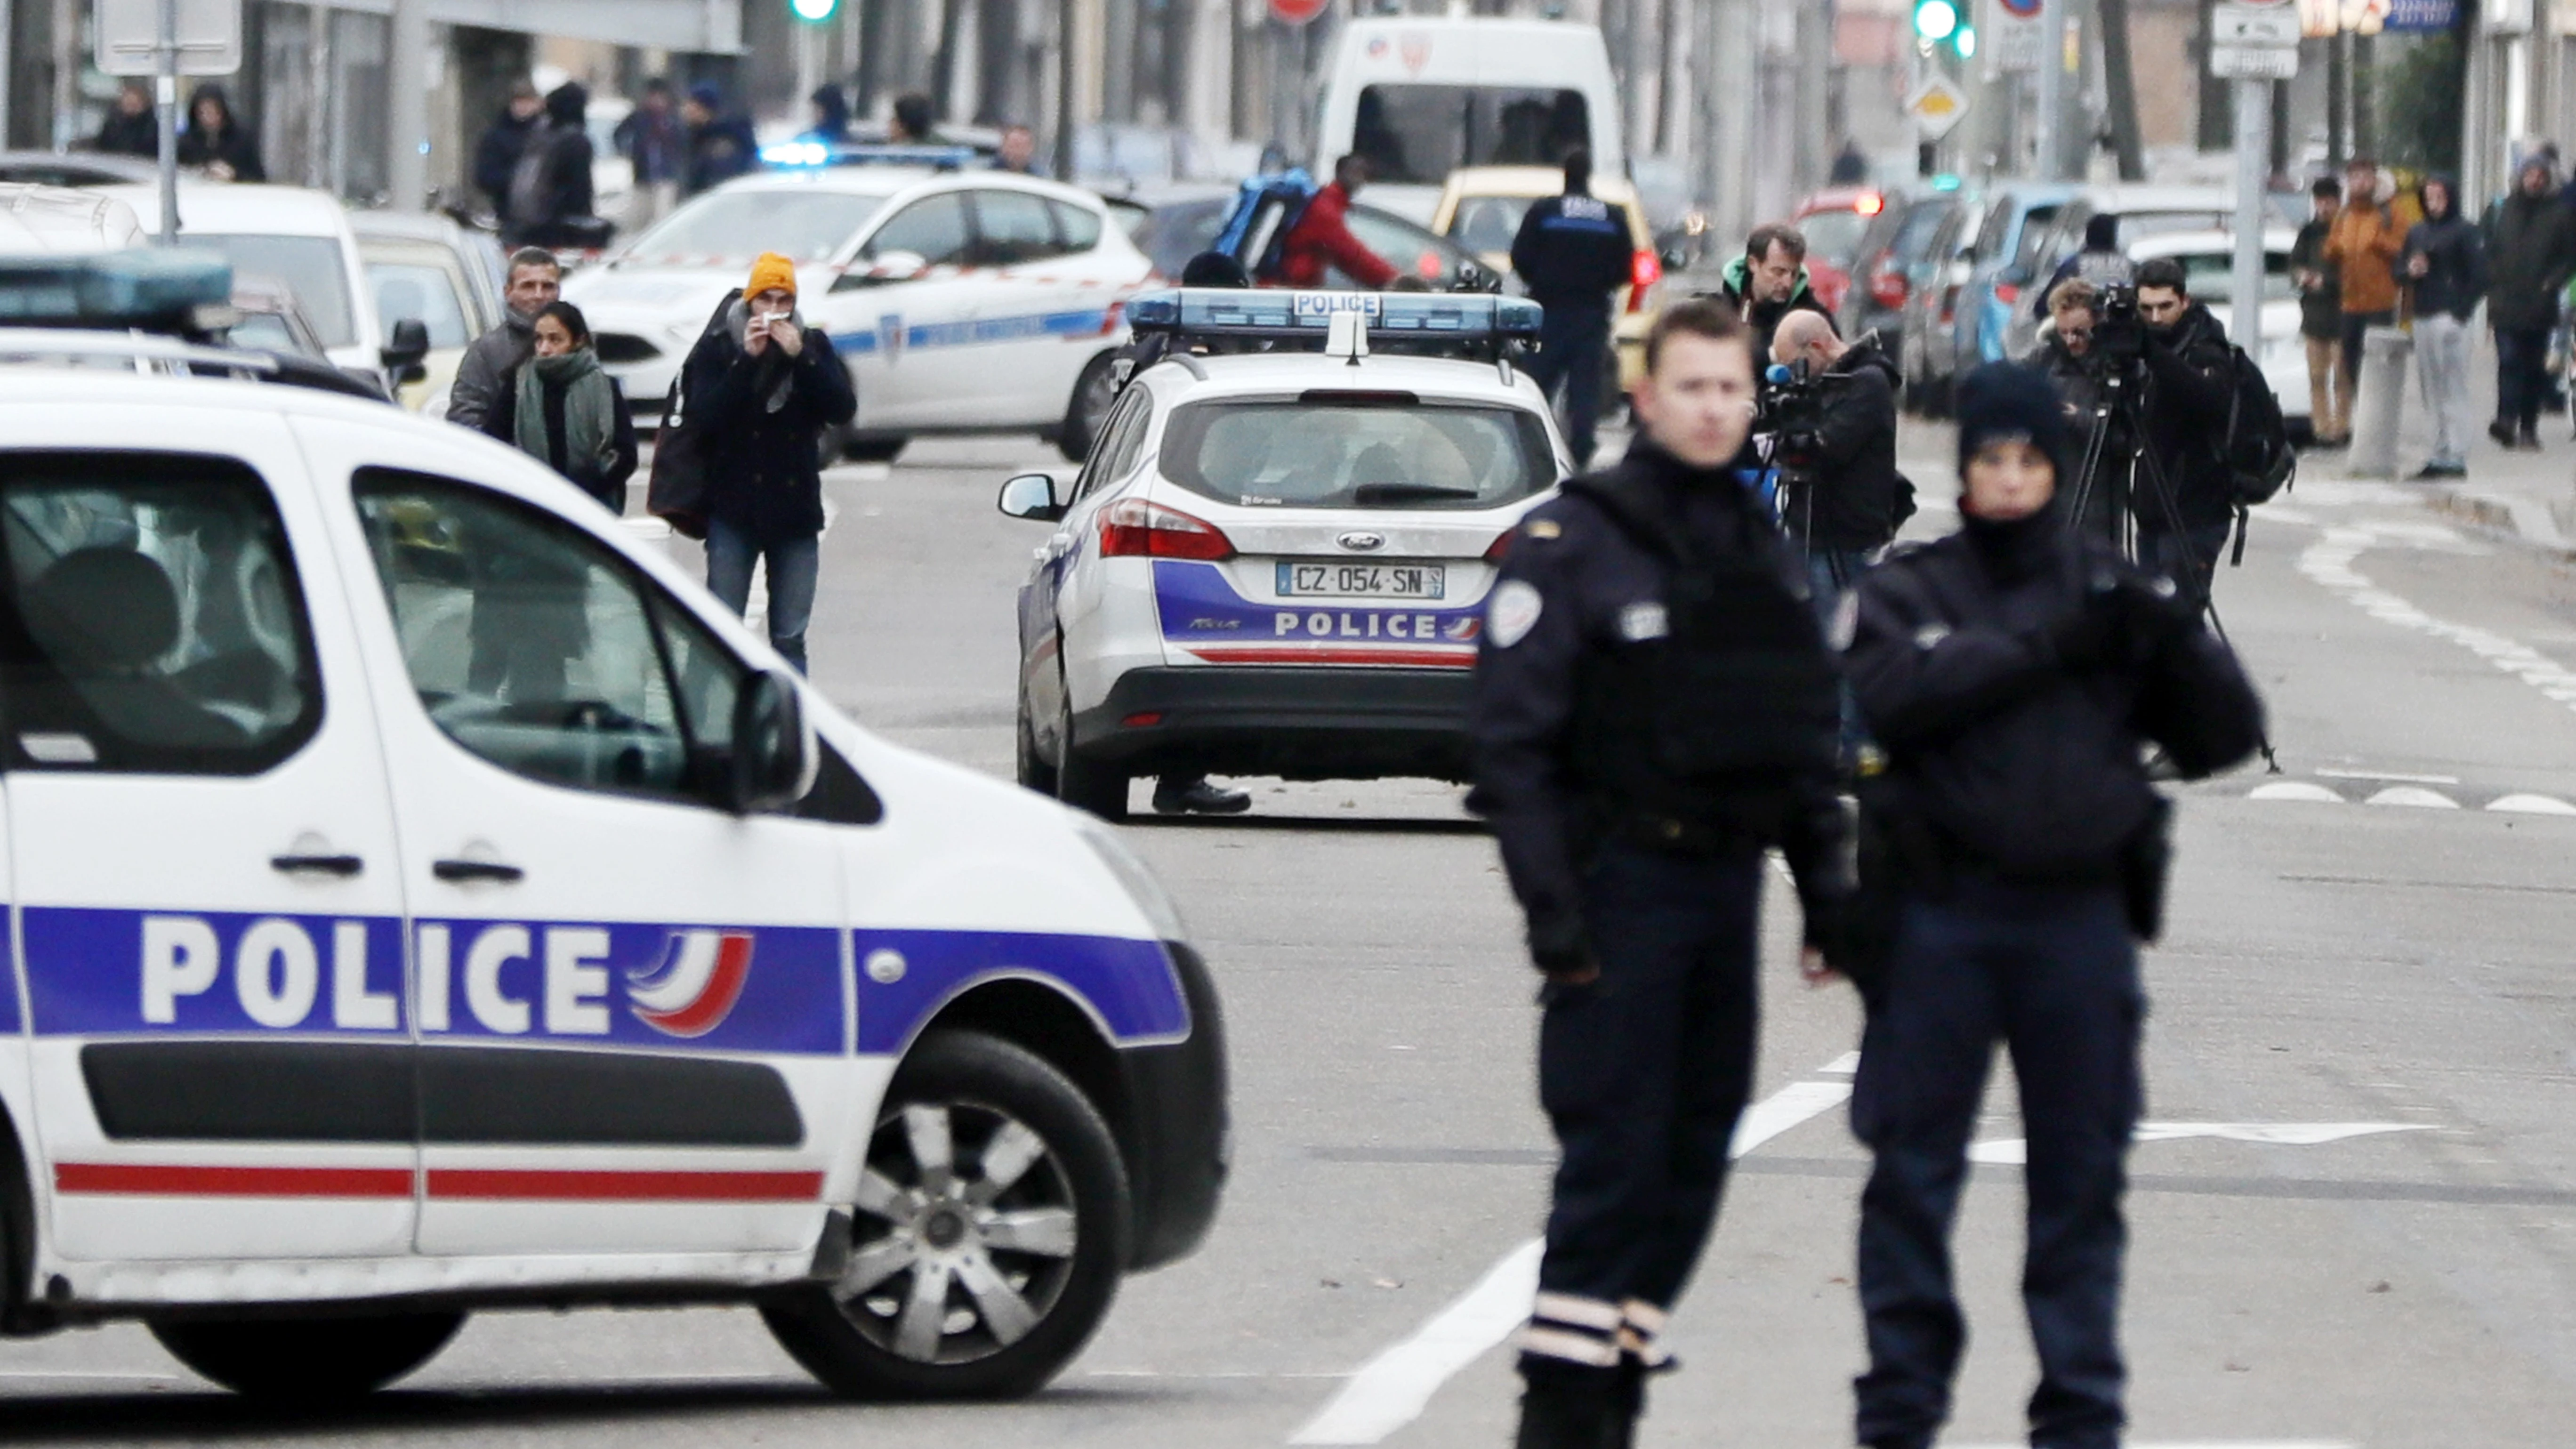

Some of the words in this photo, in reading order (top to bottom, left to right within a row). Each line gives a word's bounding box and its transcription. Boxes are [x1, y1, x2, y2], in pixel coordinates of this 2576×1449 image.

[1298, 295, 1376, 314] POLICE
[1275, 612, 1436, 638] POLICE
[141, 916, 611, 1035] POLICE
